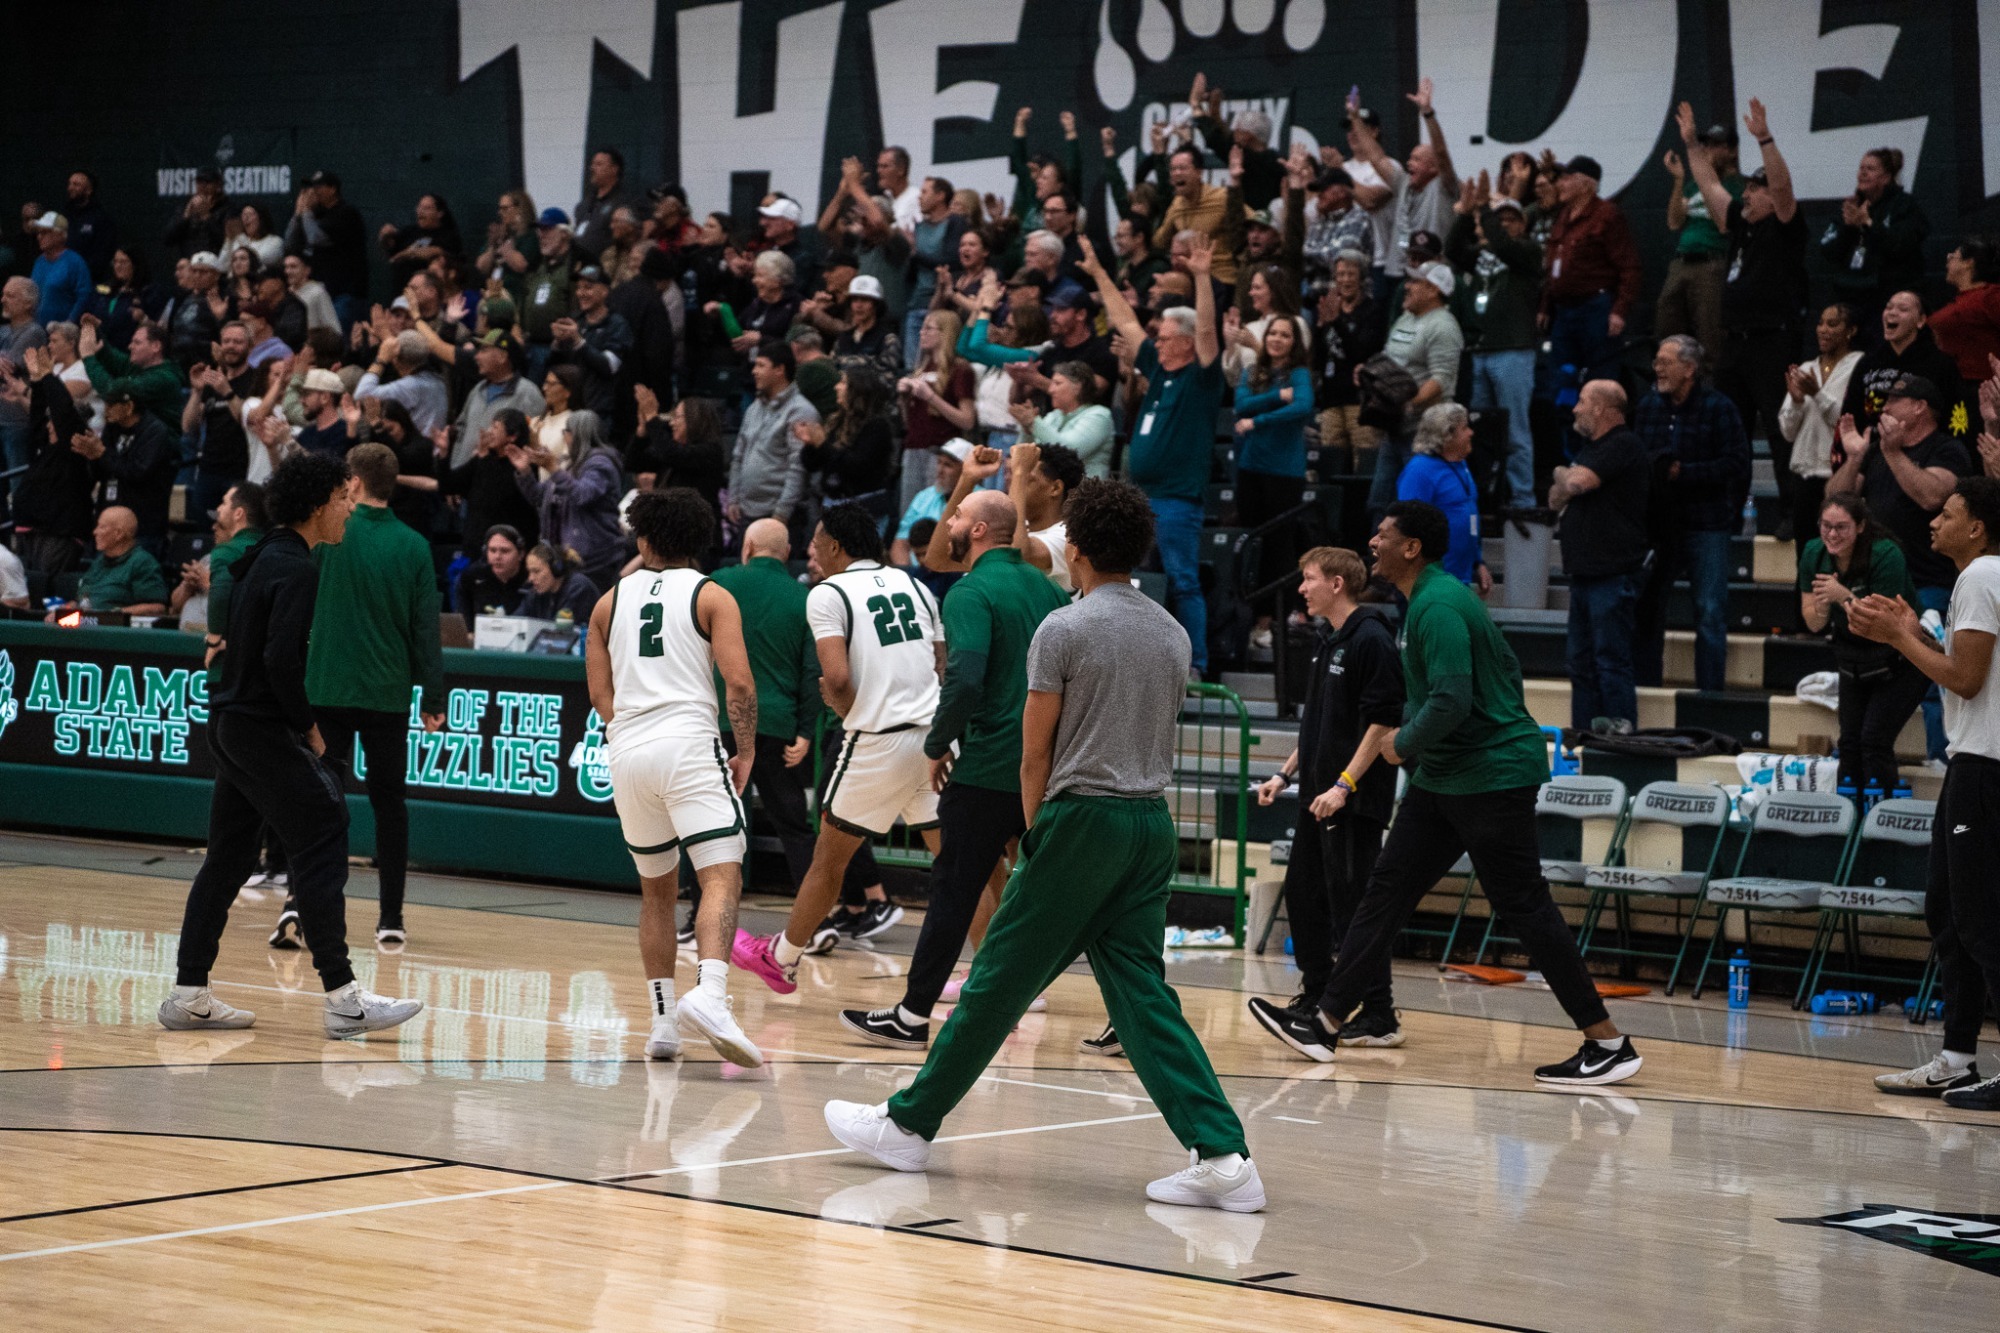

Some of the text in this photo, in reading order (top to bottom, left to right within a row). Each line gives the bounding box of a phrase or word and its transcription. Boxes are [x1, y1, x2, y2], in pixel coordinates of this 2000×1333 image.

[459, 0, 2000, 225] THE DE
[158, 165, 291, 196] VISIT SEATING
[638, 602, 665, 658] 2
[866, 592, 923, 647] 22
[447, 688, 489, 733] OF
[496, 690, 563, 738] THE
[54, 713, 190, 764] STATE
[353, 729, 560, 796] IZZLIES
[568, 742, 609, 768] ADA
[587, 766, 613, 779] STAT
[1545, 790, 1613, 807] GRIZZLIES
[1645, 795, 1716, 814] GRIZZLIES
[1766, 806, 1841, 824] GRIZZLIES
[1876, 813, 1933, 832] GRIZZL
[1603, 871, 1636, 885] 7,544
[1726, 887, 1760, 902] 7,544
[1839, 890, 1875, 906] 7,544
